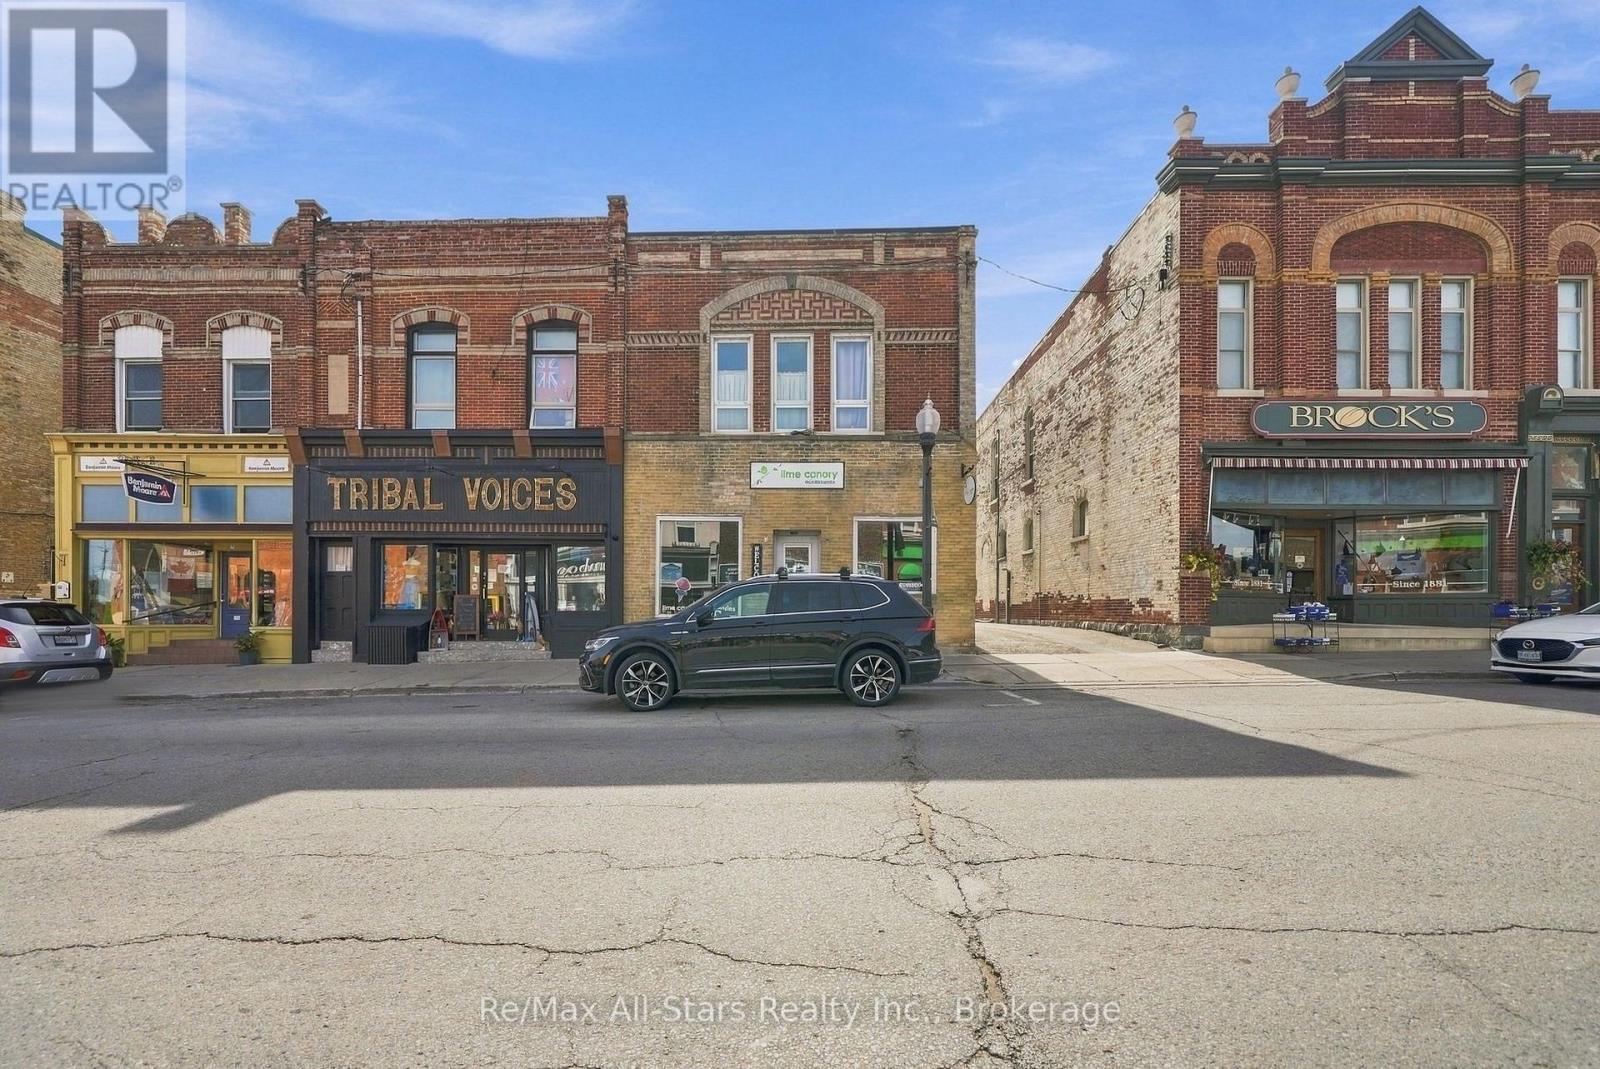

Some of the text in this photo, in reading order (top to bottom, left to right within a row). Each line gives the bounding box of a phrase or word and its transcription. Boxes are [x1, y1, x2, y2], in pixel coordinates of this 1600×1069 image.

[780, 470, 801, 478] lime
[127, 476, 161, 490] Benjamin
[132, 485, 157, 495] Moore
[327, 477, 577, 511] TRIBAL VOICES
[1392, 580, 1420, 588] Since
